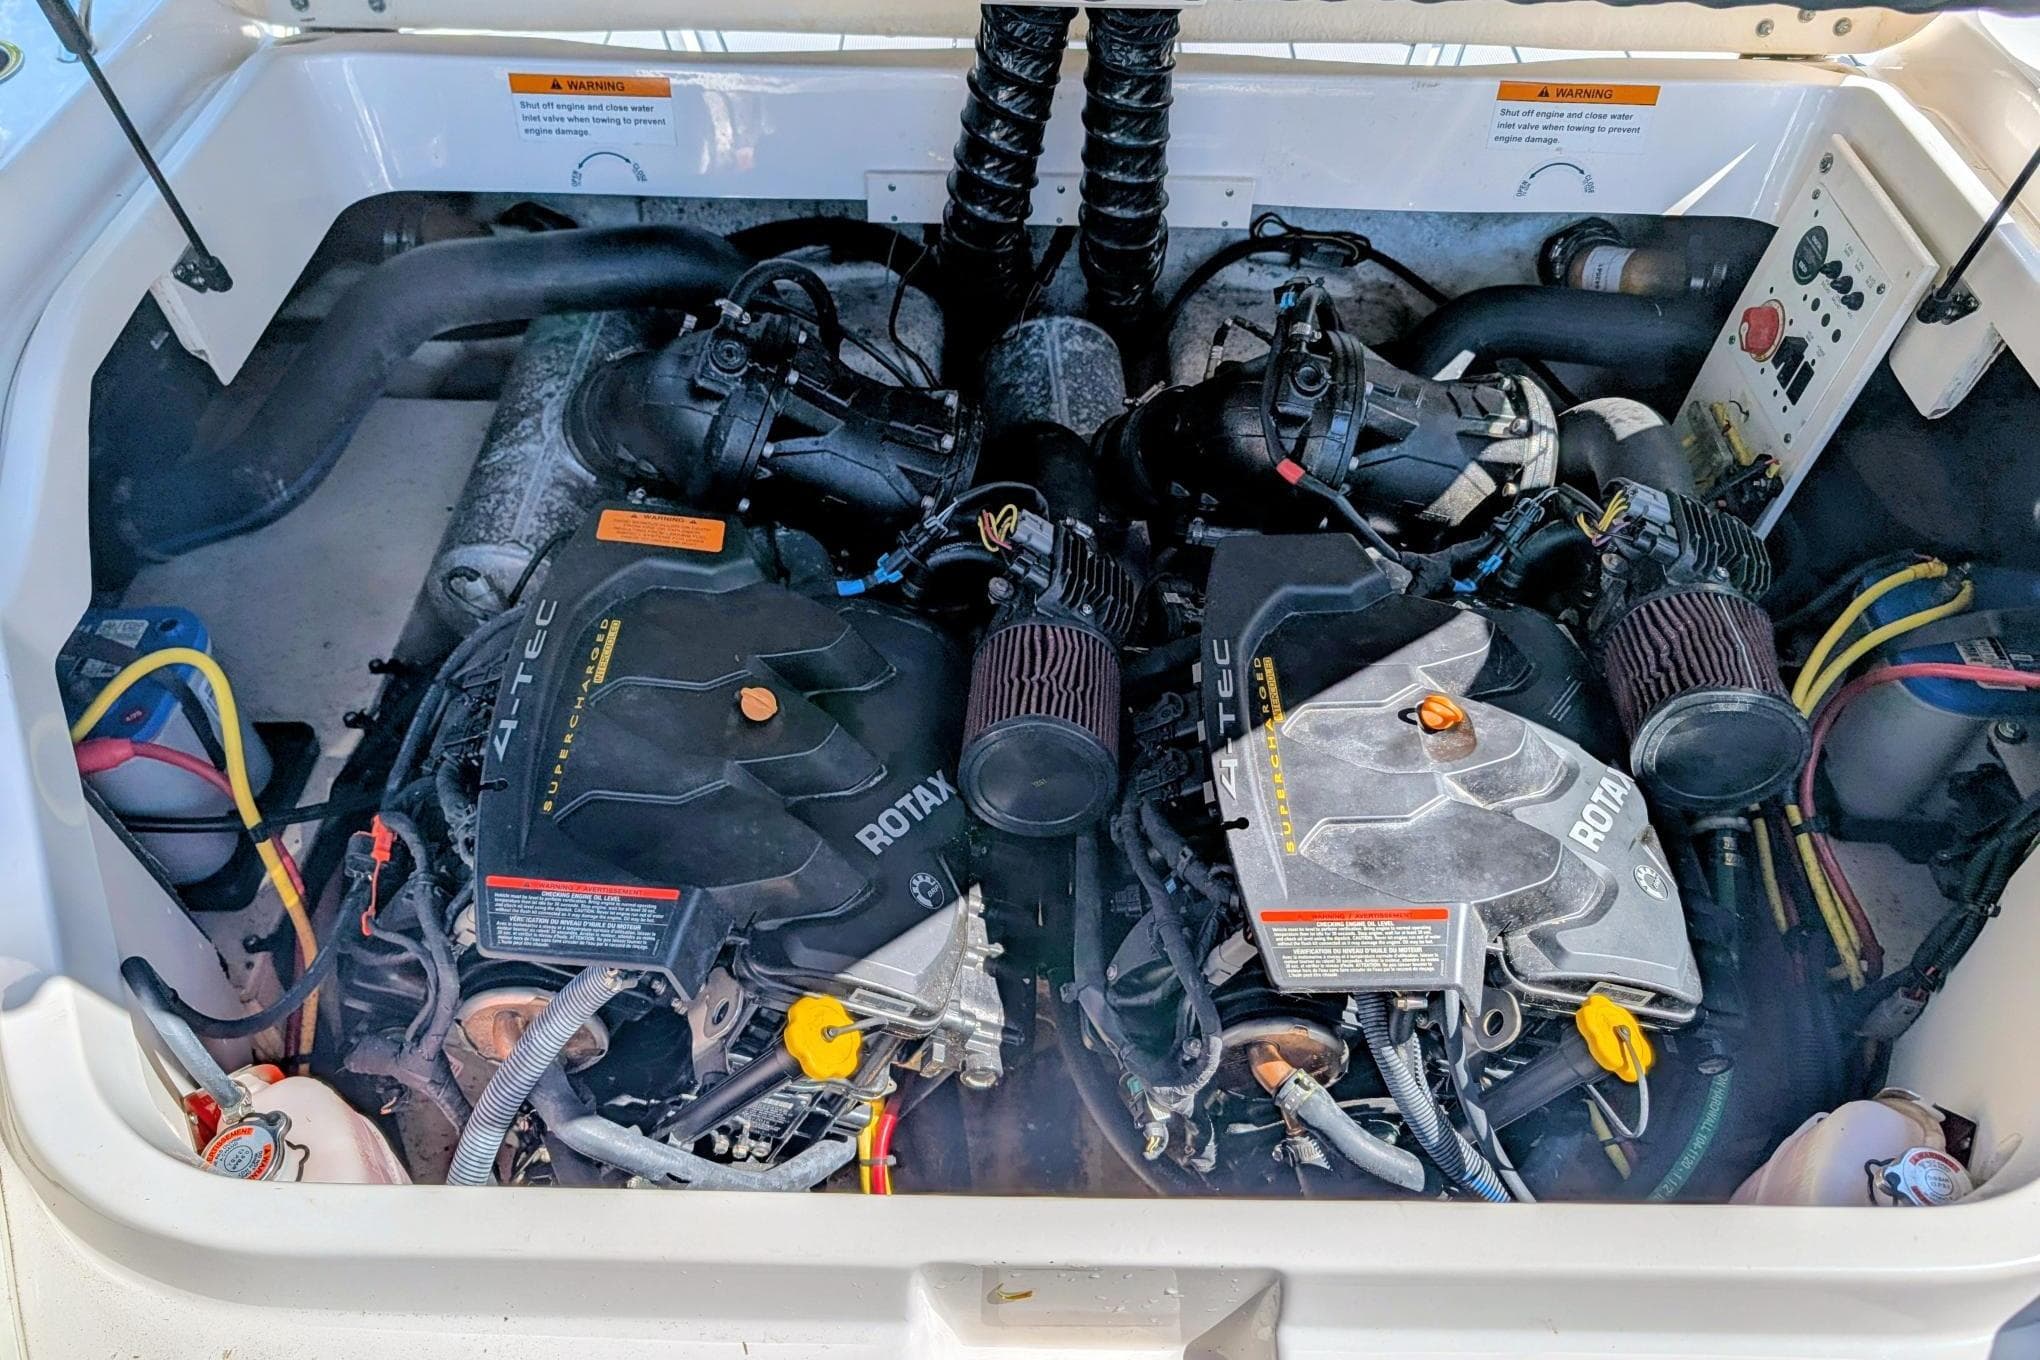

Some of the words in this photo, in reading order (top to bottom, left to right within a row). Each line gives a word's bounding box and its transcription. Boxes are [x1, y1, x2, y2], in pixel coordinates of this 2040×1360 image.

[567, 80, 625, 92] WARNING
[1555, 88, 1613, 99] WARNING
[519, 101, 540, 110] Shut
[542, 102, 554, 110] off
[556, 103, 585, 113] engine
[587, 103, 603, 111] and
[605, 103, 628, 112] close
[522, 114, 541, 122] inlet
[542, 115, 565, 123] valve
[567, 115, 590, 124] when
[592, 116, 621, 126] towing
[623, 117, 632, 125] to
[634, 118, 666, 127] prevent
[1500, 108, 1520, 117] Shut
[1522, 109, 1535, 118] off
[1536, 111, 1565, 121] engine
[1584, 112, 1608, 120] close
[1610, 113, 1633, 121] water
[524, 128, 553, 136] engine
[555, 128, 591, 137] damage.
[1497, 122, 1516, 130] inlet
[1518, 122, 1539, 131] valve
[1542, 123, 1565, 131] when
[1566, 124, 1595, 134] towing
[1597, 125, 1606, 133] to
[1608, 126, 1641, 135] prevent
[1494, 135, 1523, 144] engine
[1525, 136, 1560, 145] damage.
[1516, 181, 1528, 197] OPEN
[643, 514, 685, 523] WARNING
[493, 599, 558, 762] 4-TEC
[543, 618, 609, 813] SUPERCHARGED
[1213, 639, 1238, 800] 4-TEC
[1254, 657, 1296, 854] SUPERCHARGED
[854, 769, 958, 856] ROTAX
[1568, 767, 1635, 853] ROTAX
[539, 882, 573, 891] WARNING
[583, 886, 643, 896] AVERTISSEMENT
[927, 884, 939, 898] BRP
[1701, 1088, 1727, 1131] HARDWALL
[1681, 1134, 1706, 1169] 104-1120
